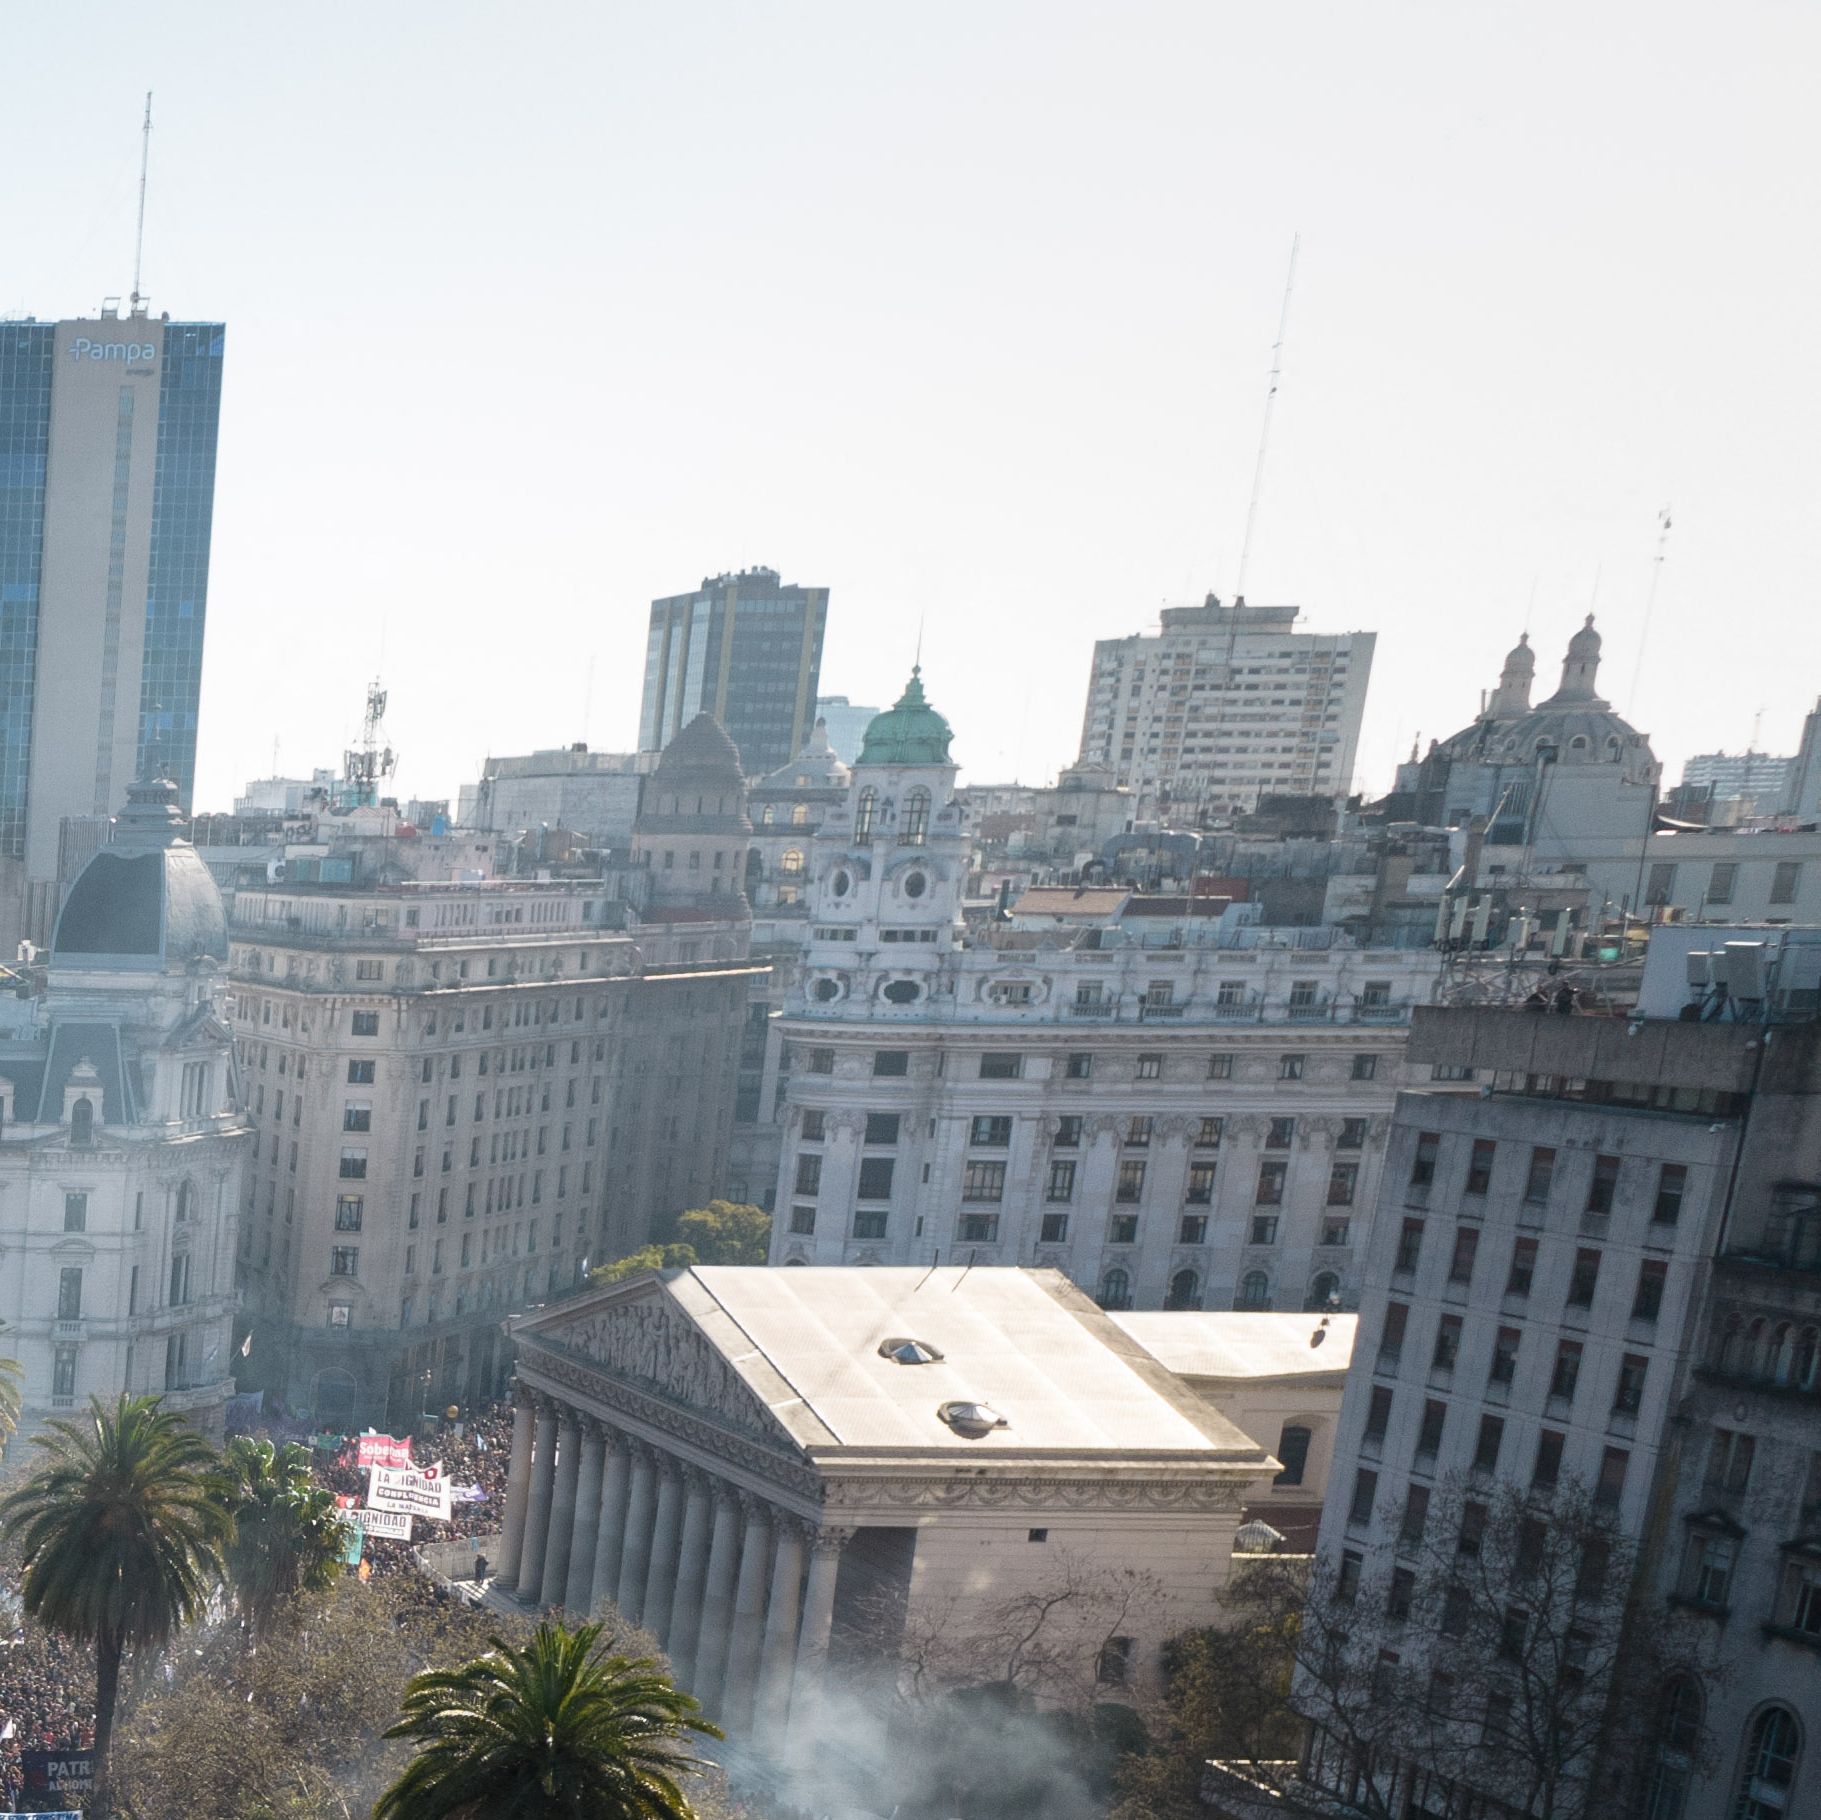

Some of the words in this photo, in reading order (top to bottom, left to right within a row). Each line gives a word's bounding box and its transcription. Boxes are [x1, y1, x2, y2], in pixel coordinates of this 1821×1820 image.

[72, 337, 155, 365] Pampa
[378, 1471, 390, 1483] LA
[394, 1474, 442, 1493] IGNIDAD
